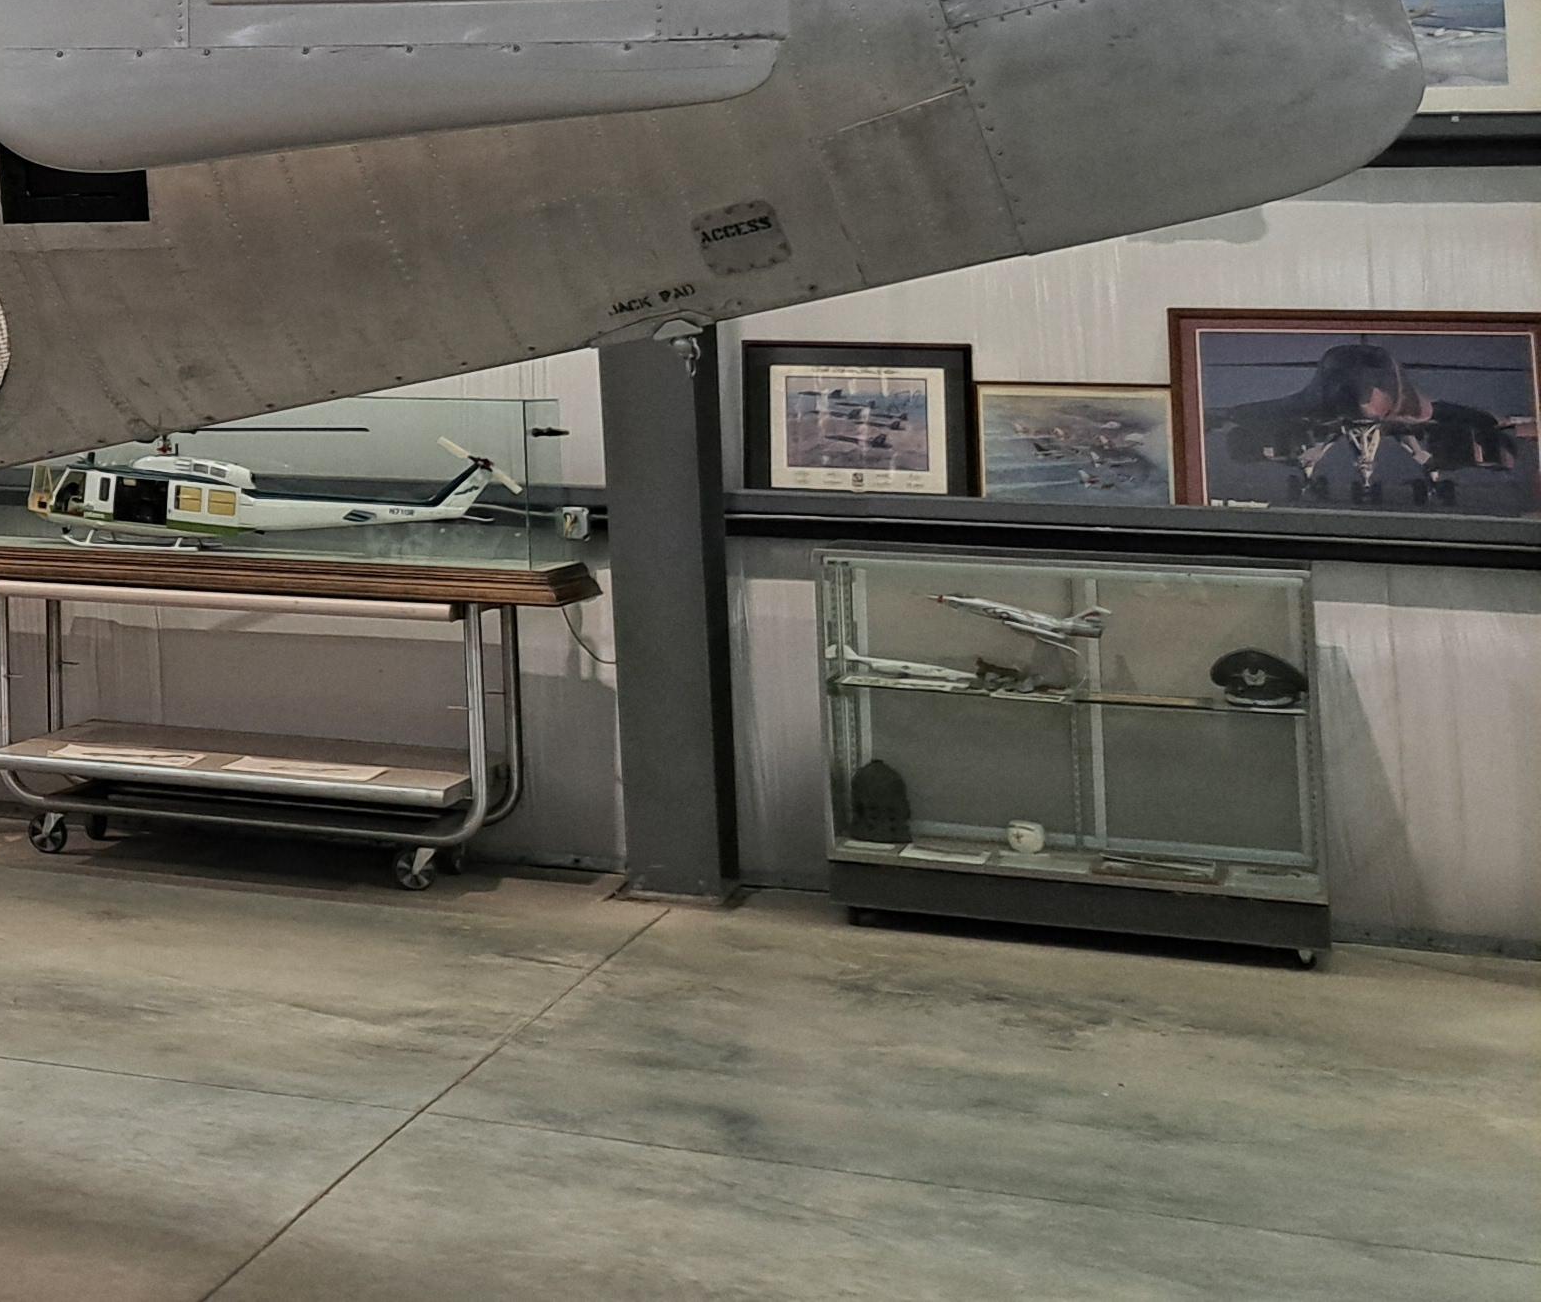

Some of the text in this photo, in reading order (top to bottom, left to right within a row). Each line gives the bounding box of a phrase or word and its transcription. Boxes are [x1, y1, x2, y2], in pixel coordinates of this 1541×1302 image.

[700, 215, 773, 244] ACCESS
[607, 283, 697, 316] JACK PAD
